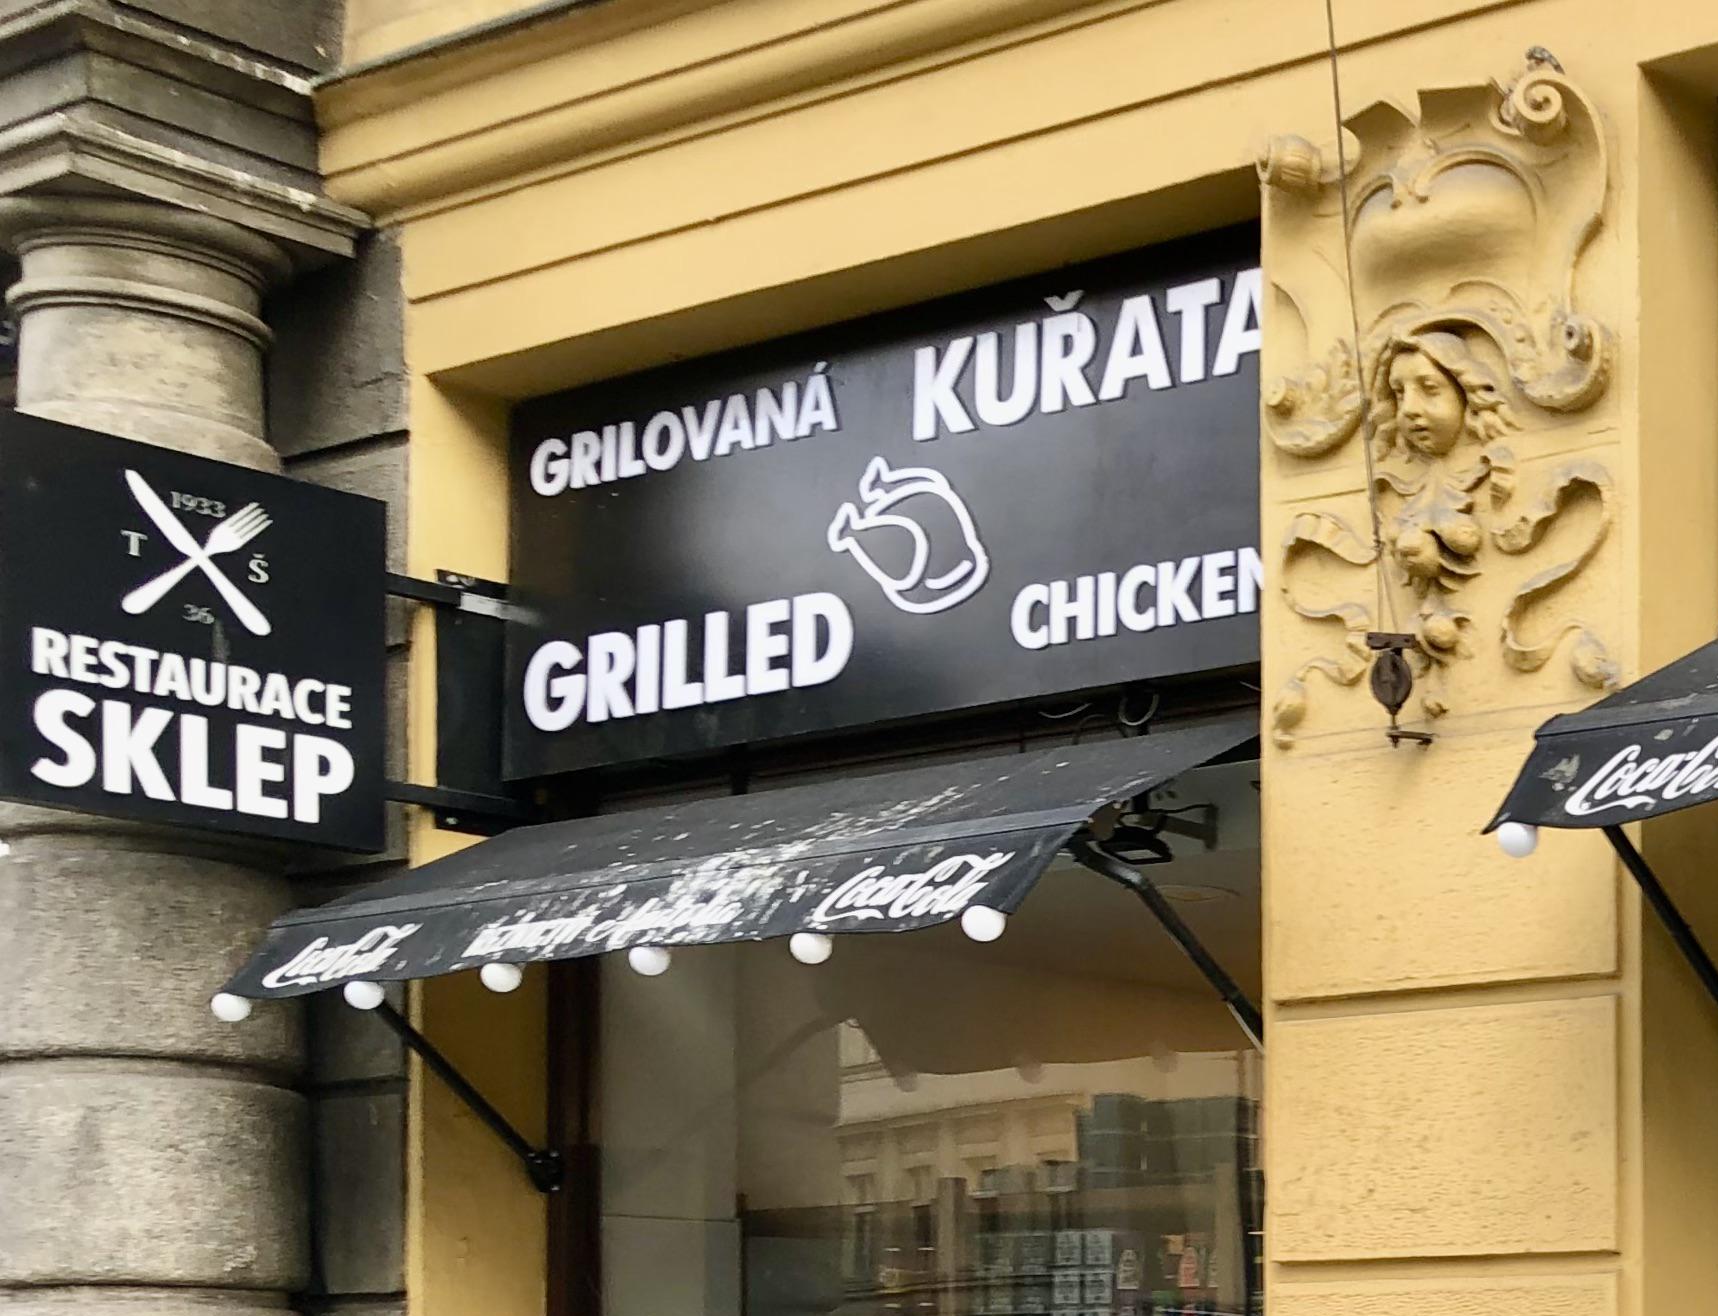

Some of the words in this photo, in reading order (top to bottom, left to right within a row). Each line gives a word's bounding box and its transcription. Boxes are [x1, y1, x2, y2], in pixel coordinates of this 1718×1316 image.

[529, 361, 836, 497] GRILOVANÁ
[911, 268, 1263, 442] KUŘATA
[170, 490, 227, 519] 1933
[121, 529, 148, 557] T
[247, 553, 270, 584] Š
[522, 590, 855, 733] GRILLED
[1009, 545, 1264, 650] CHICKEN
[30, 626, 353, 730] RESTAURACE
[29, 688, 355, 825] SKLEP
[811, 851, 1017, 923] Coca-Cola
[262, 923, 424, 989] Coca-Cola
